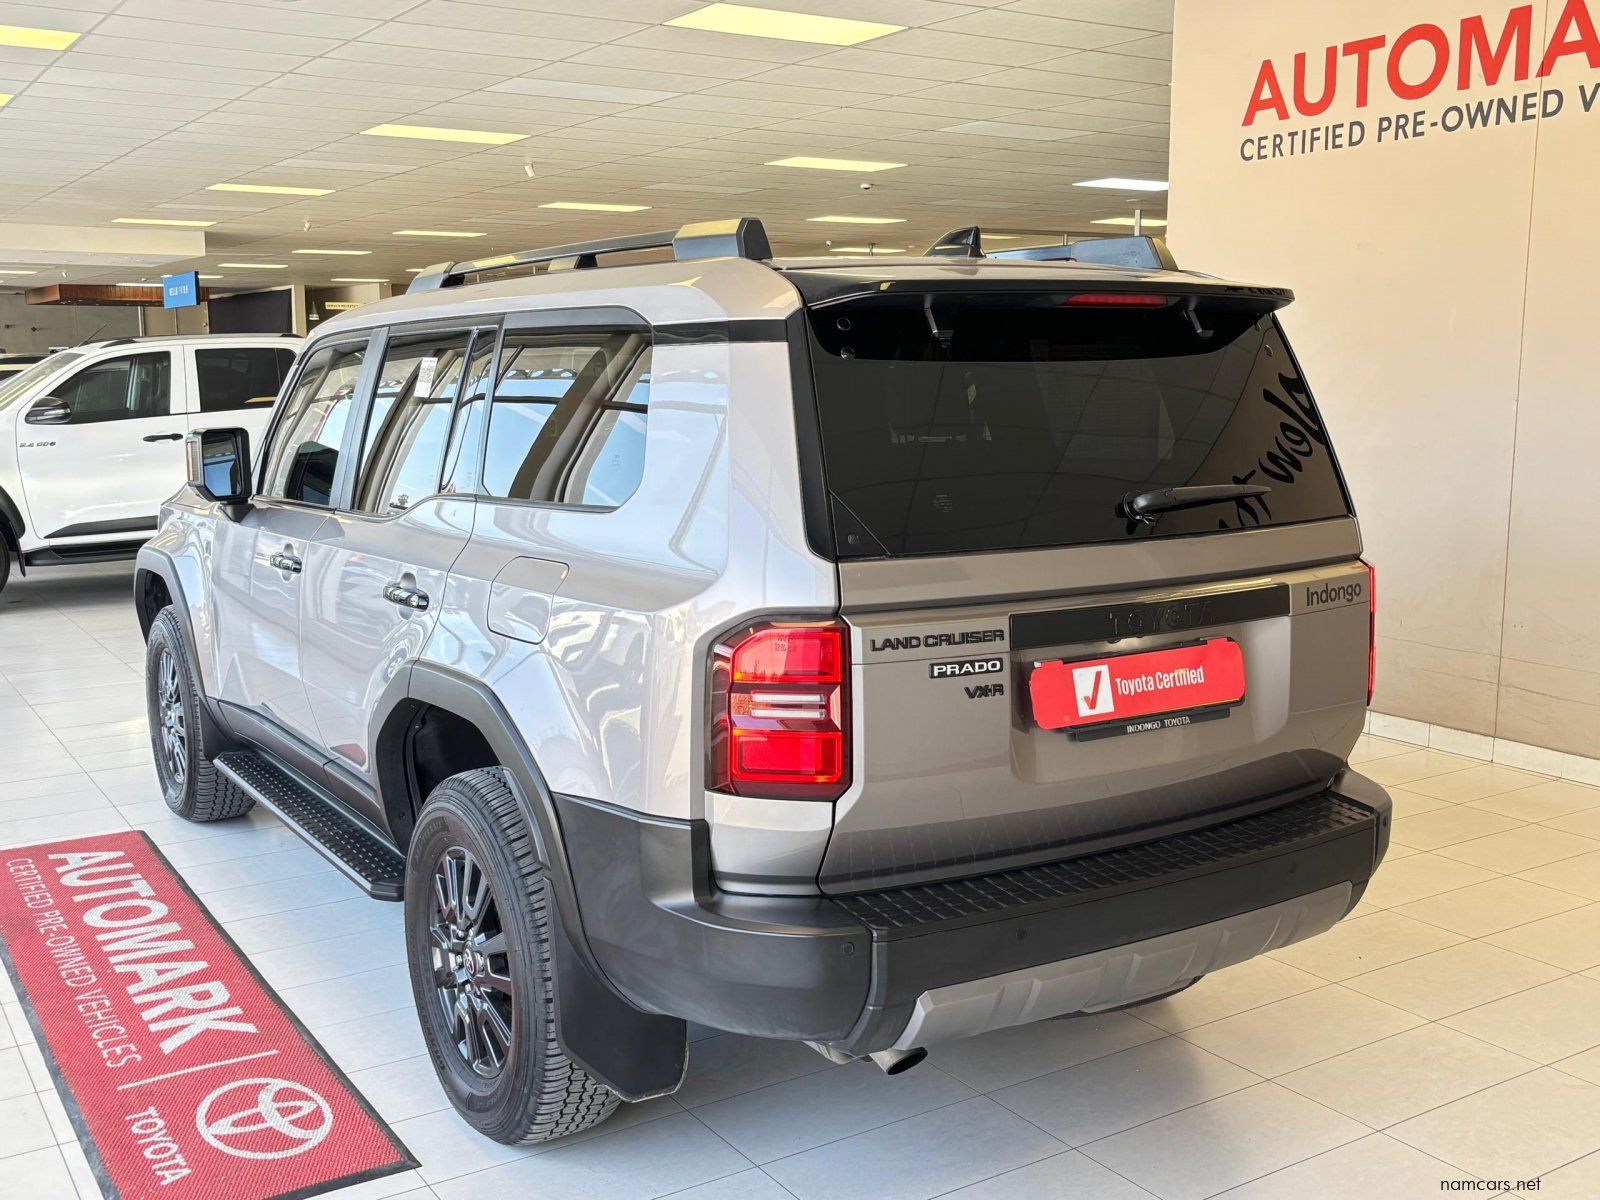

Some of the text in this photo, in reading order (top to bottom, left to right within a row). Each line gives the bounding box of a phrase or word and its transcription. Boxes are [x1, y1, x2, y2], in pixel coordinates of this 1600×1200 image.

[1240, 120, 1366, 162] CERTIFIED
[1377, 89, 1564, 143] PRE-OWNED
[1306, 582, 1362, 607] Indongo
[1107, 601, 1215, 637] TOYOTA
[870, 629, 1005, 652] LAND CRUISER
[933, 660, 1001, 677] PRADO
[1115, 665, 1205, 696] Toyota Certified
[1126, 716, 1191, 734] INDONGO TOYOTA
[6, 858, 143, 1068] CERTIFIED PRE-OWNED VEHICLES
[47, 851, 258, 1055] AUTOMARK
[124, 1106, 192, 1186] TOYOTA
